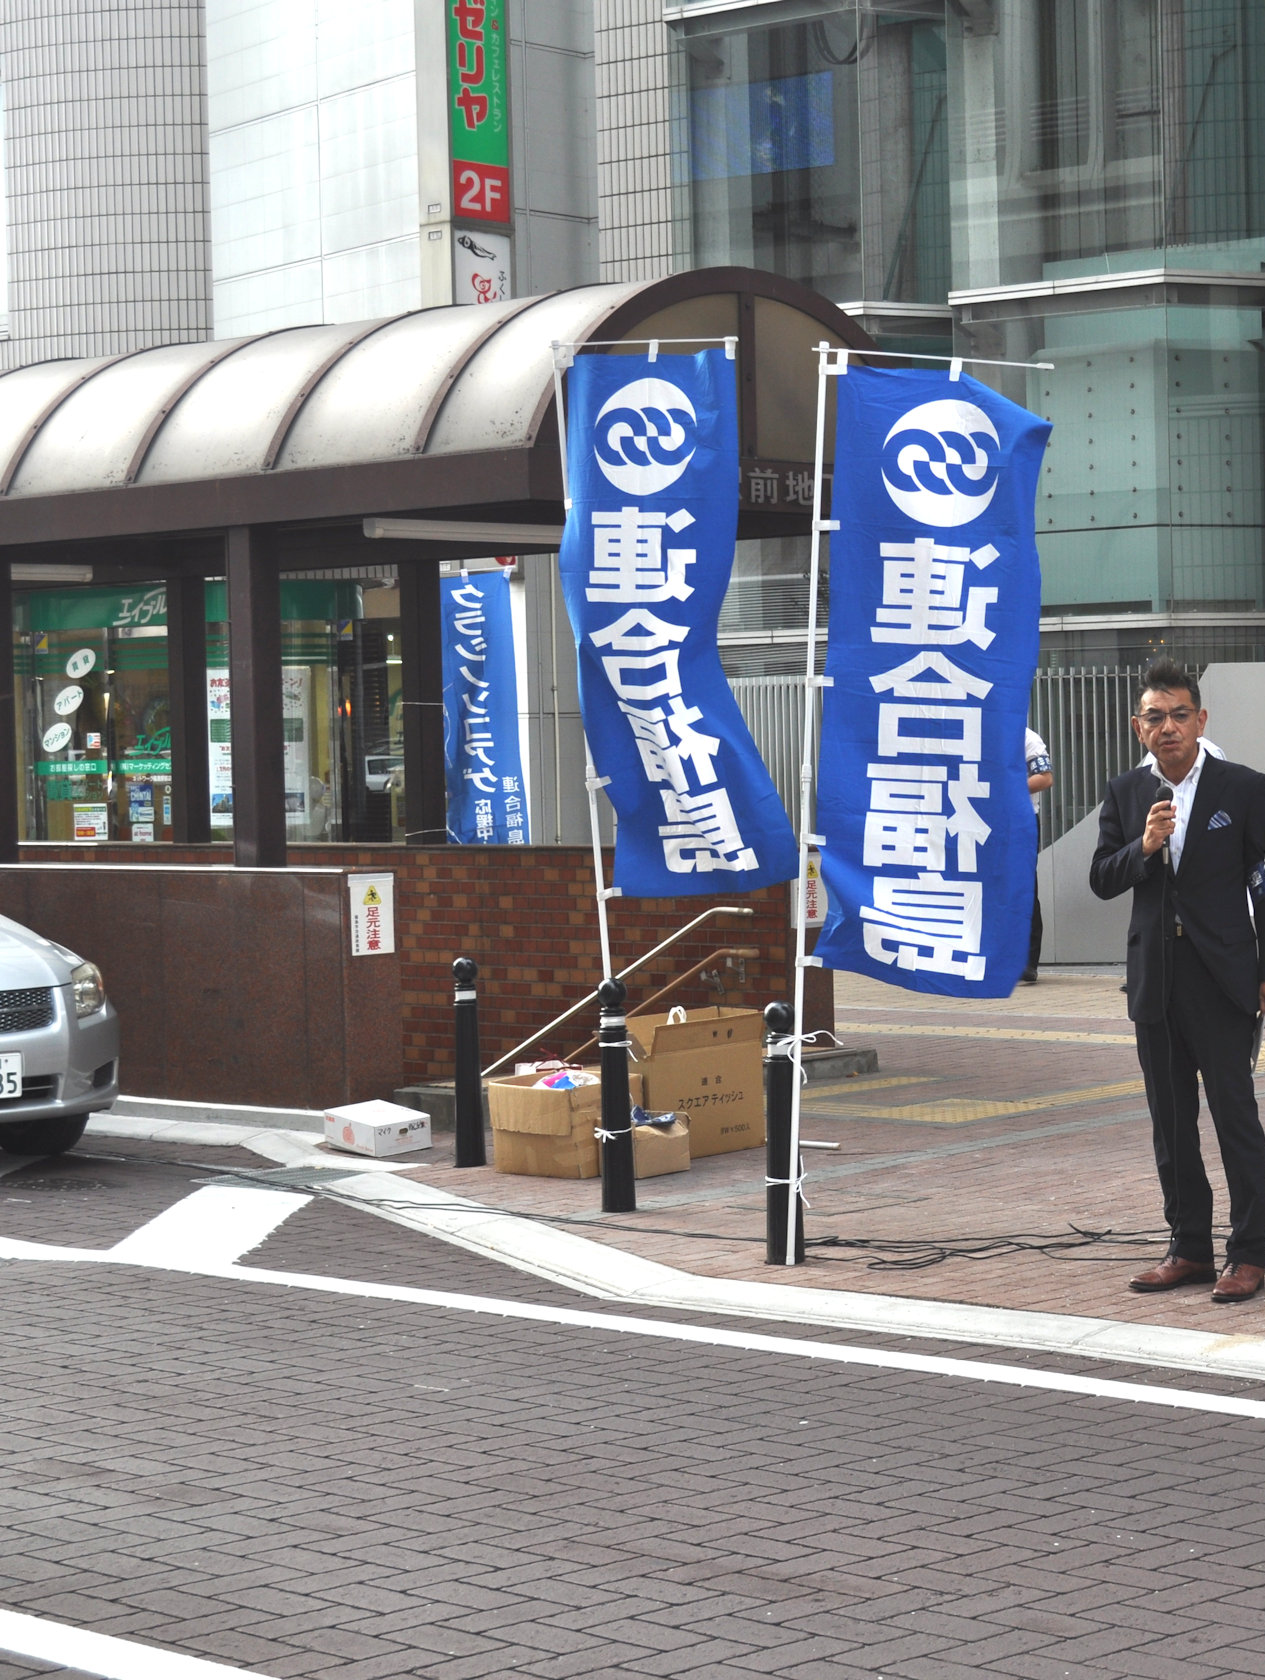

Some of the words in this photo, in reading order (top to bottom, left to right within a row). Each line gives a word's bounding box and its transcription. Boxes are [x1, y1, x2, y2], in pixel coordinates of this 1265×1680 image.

[460, 169, 502, 212] 2F
[738, 466, 833, 506] 前地
[113, 587, 167, 626] エイブル
[56, 689, 83, 711] アパート
[806, 880, 818, 919] 足元注意
[366, 906, 381, 951] 足元注意
